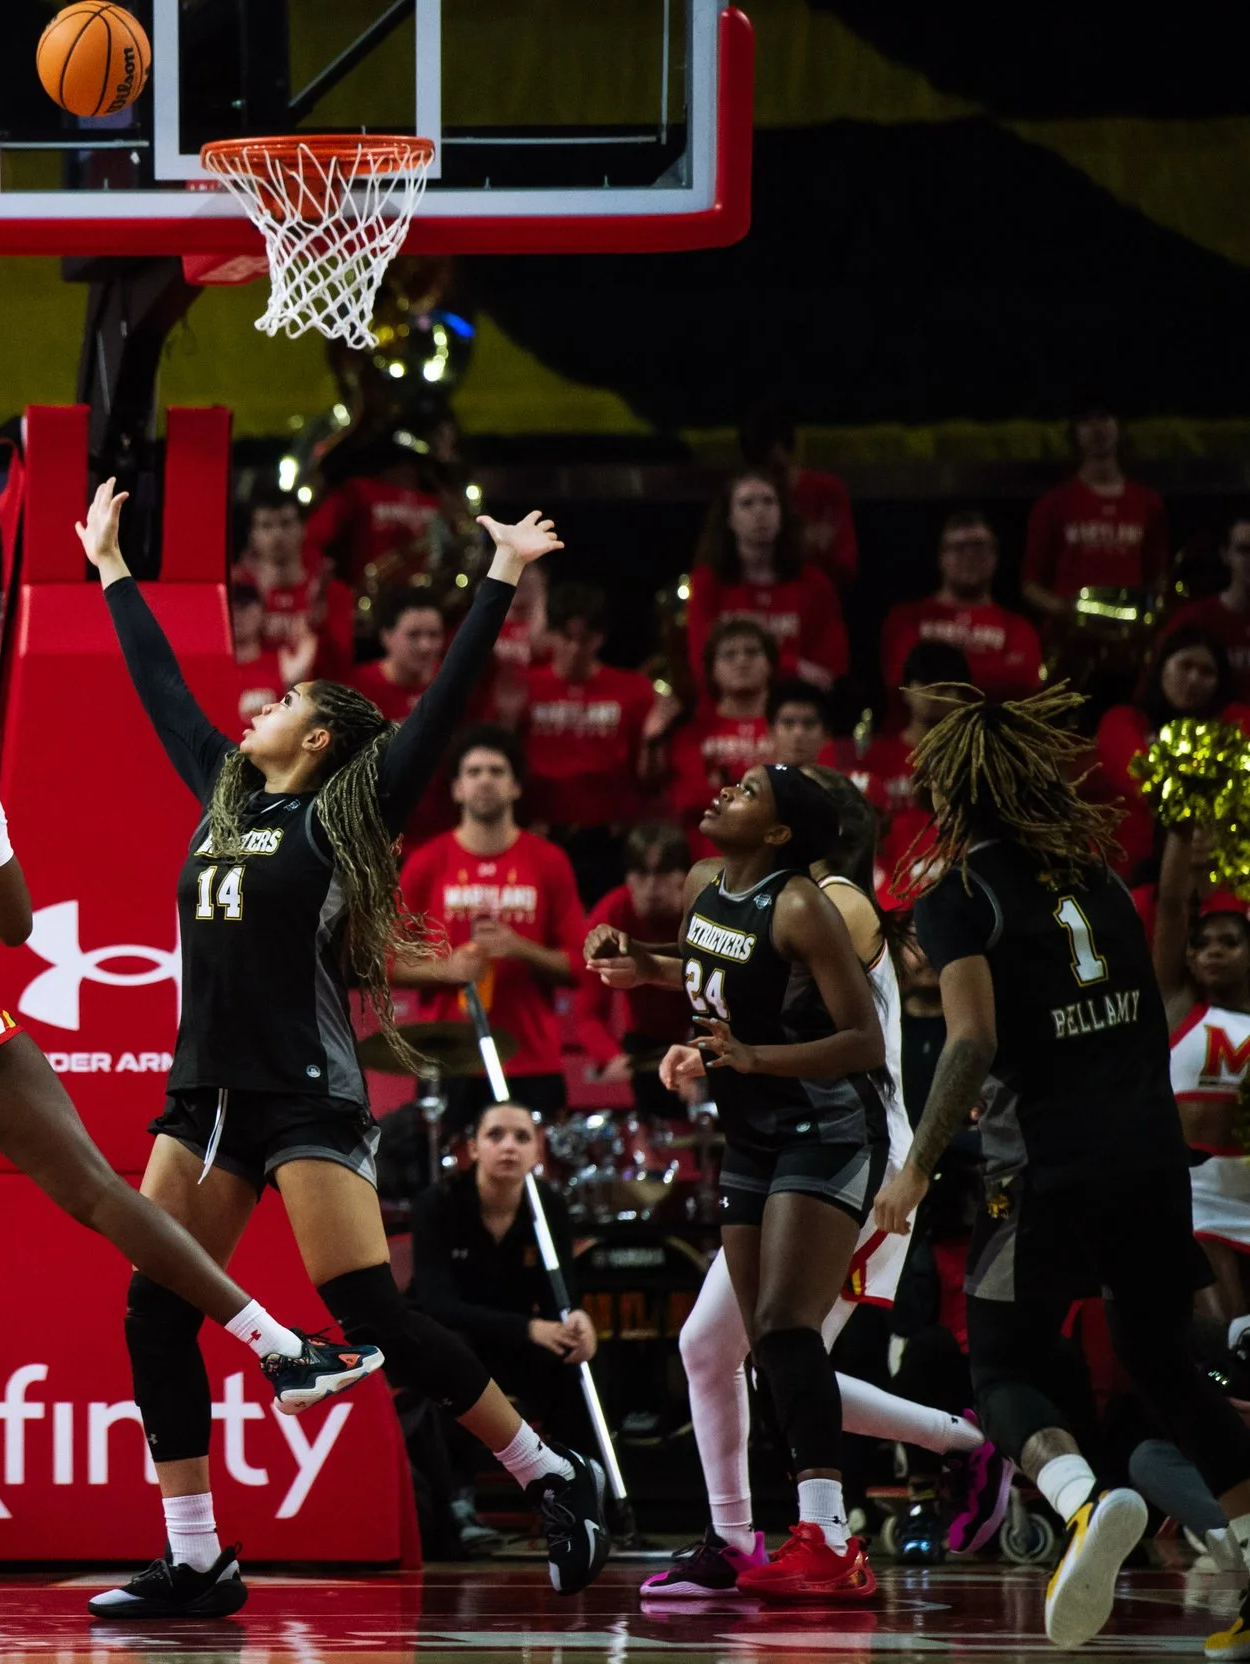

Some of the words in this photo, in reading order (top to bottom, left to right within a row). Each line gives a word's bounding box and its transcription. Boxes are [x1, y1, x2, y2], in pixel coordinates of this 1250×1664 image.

[106, 47, 135, 113] Wilson
[195, 865, 246, 921] 14
[1053, 895, 1110, 988] 1
[686, 957, 732, 1021] 24
[1051, 989, 1141, 1040] BELLAMY
[43, 1051, 111, 1072] DER
[1202, 1023, 1250, 1077] M
